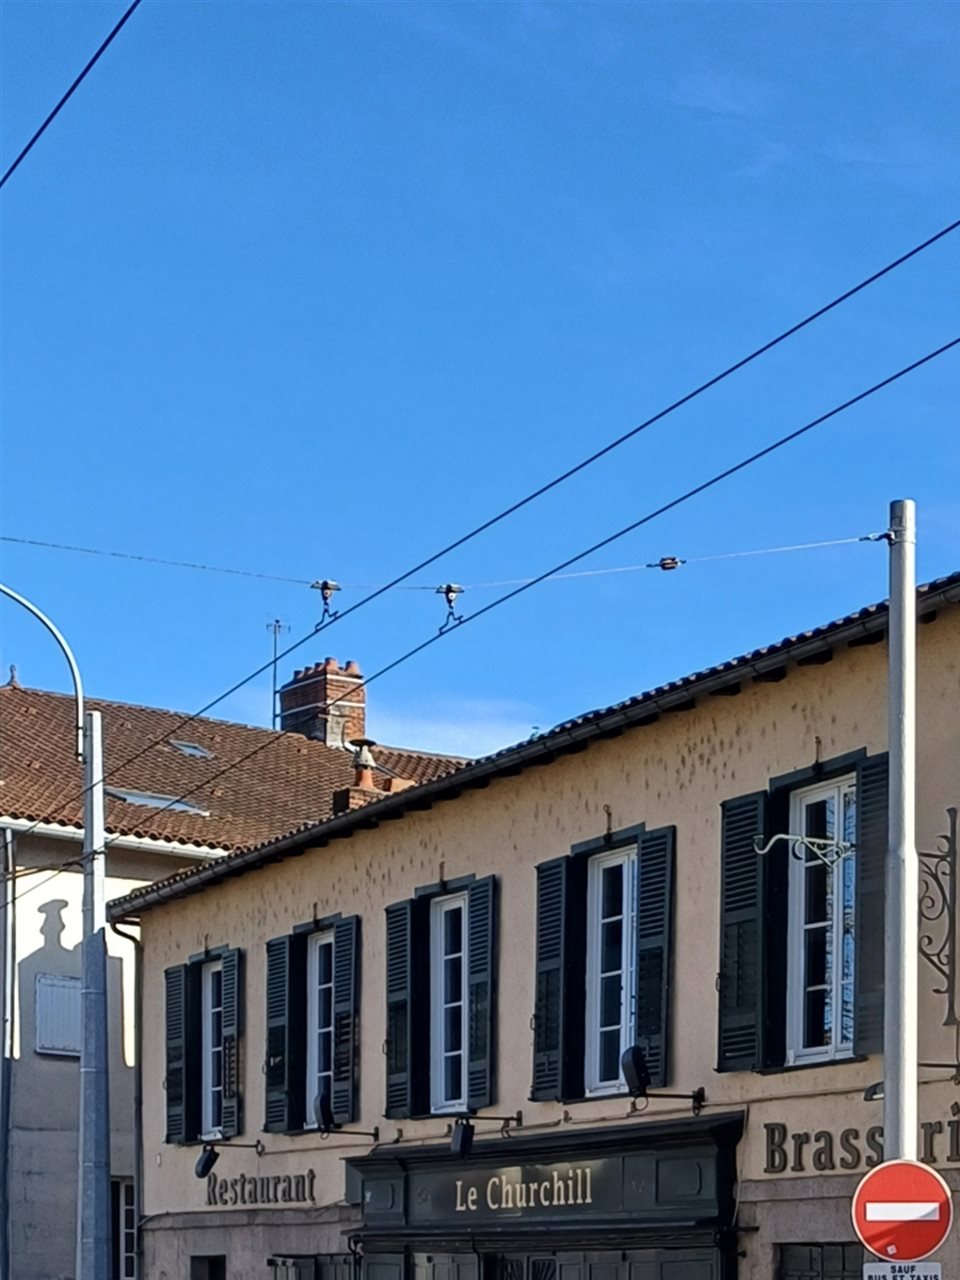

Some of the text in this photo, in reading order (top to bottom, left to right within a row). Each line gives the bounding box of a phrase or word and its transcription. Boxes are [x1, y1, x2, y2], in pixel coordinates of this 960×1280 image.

[206, 1168, 316, 1206] Restaurant
[455, 1167, 592, 1212] Le Churchill
[890, 1265, 916, 1274] SAUF
